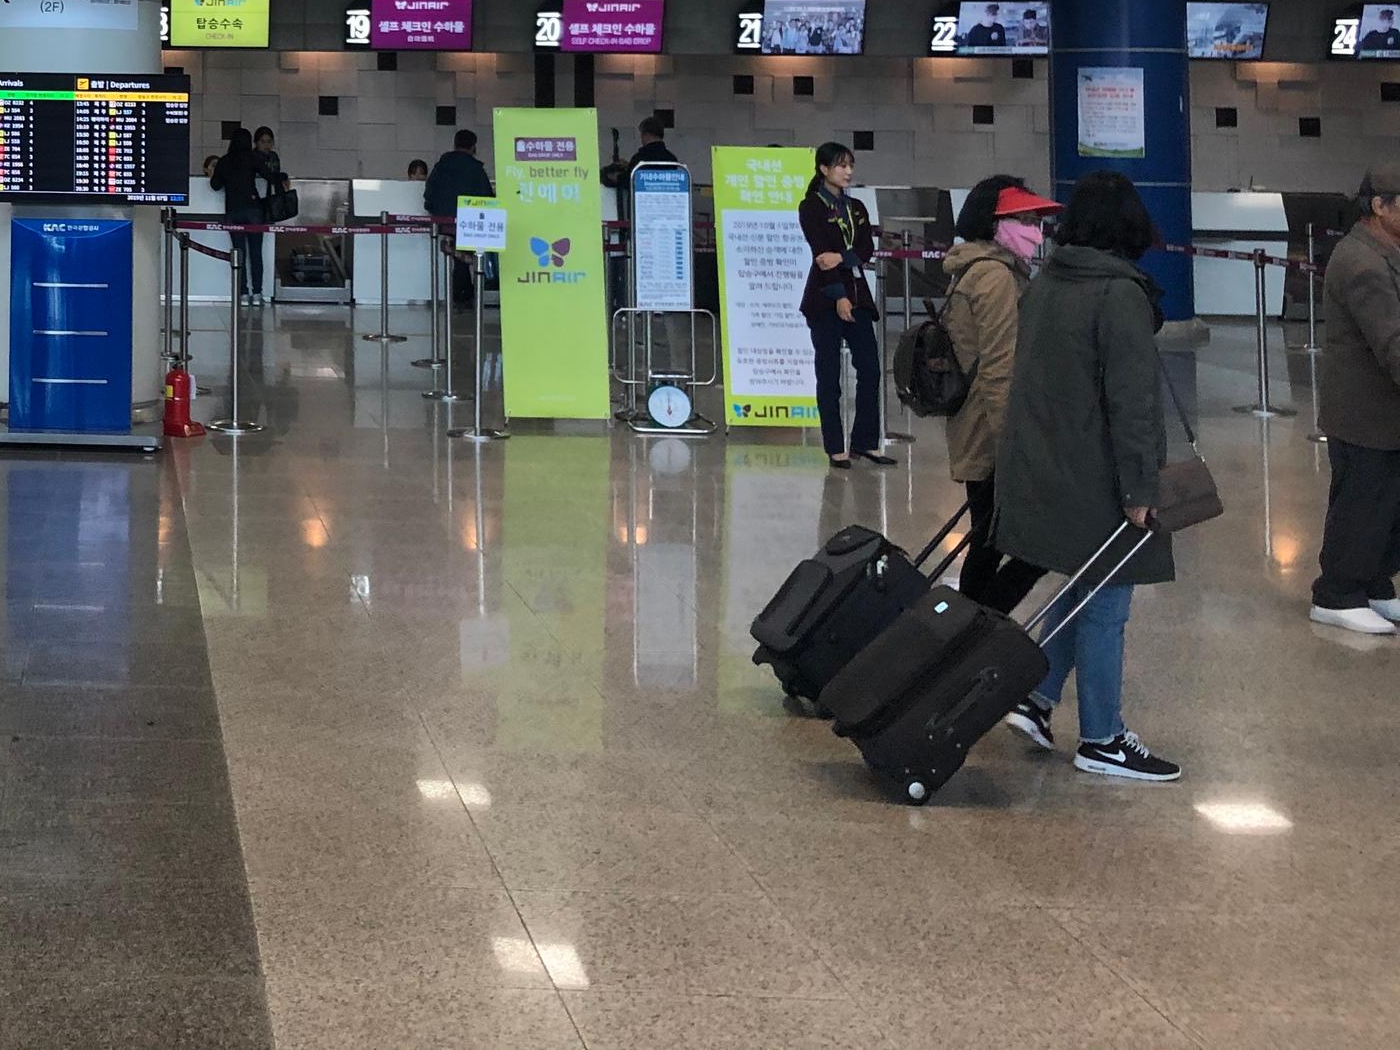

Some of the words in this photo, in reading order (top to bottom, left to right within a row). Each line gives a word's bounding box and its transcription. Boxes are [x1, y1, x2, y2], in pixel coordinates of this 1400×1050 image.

[40, 0, 64, 14] (2F)
[196, 17, 243, 31] 탑승수속
[346, 15, 371, 39] 19
[535, 16, 561, 41] 20
[739, 19, 761, 43] 21
[932, 22, 957, 46] 22
[1332, 24, 1357, 48] 24
[110, 80, 150, 89] Departures
[530, 166, 569, 178] better
[574, 166, 589, 180] fly
[43, 223, 66, 232] KAC
[459, 221, 485, 232] 수하물
